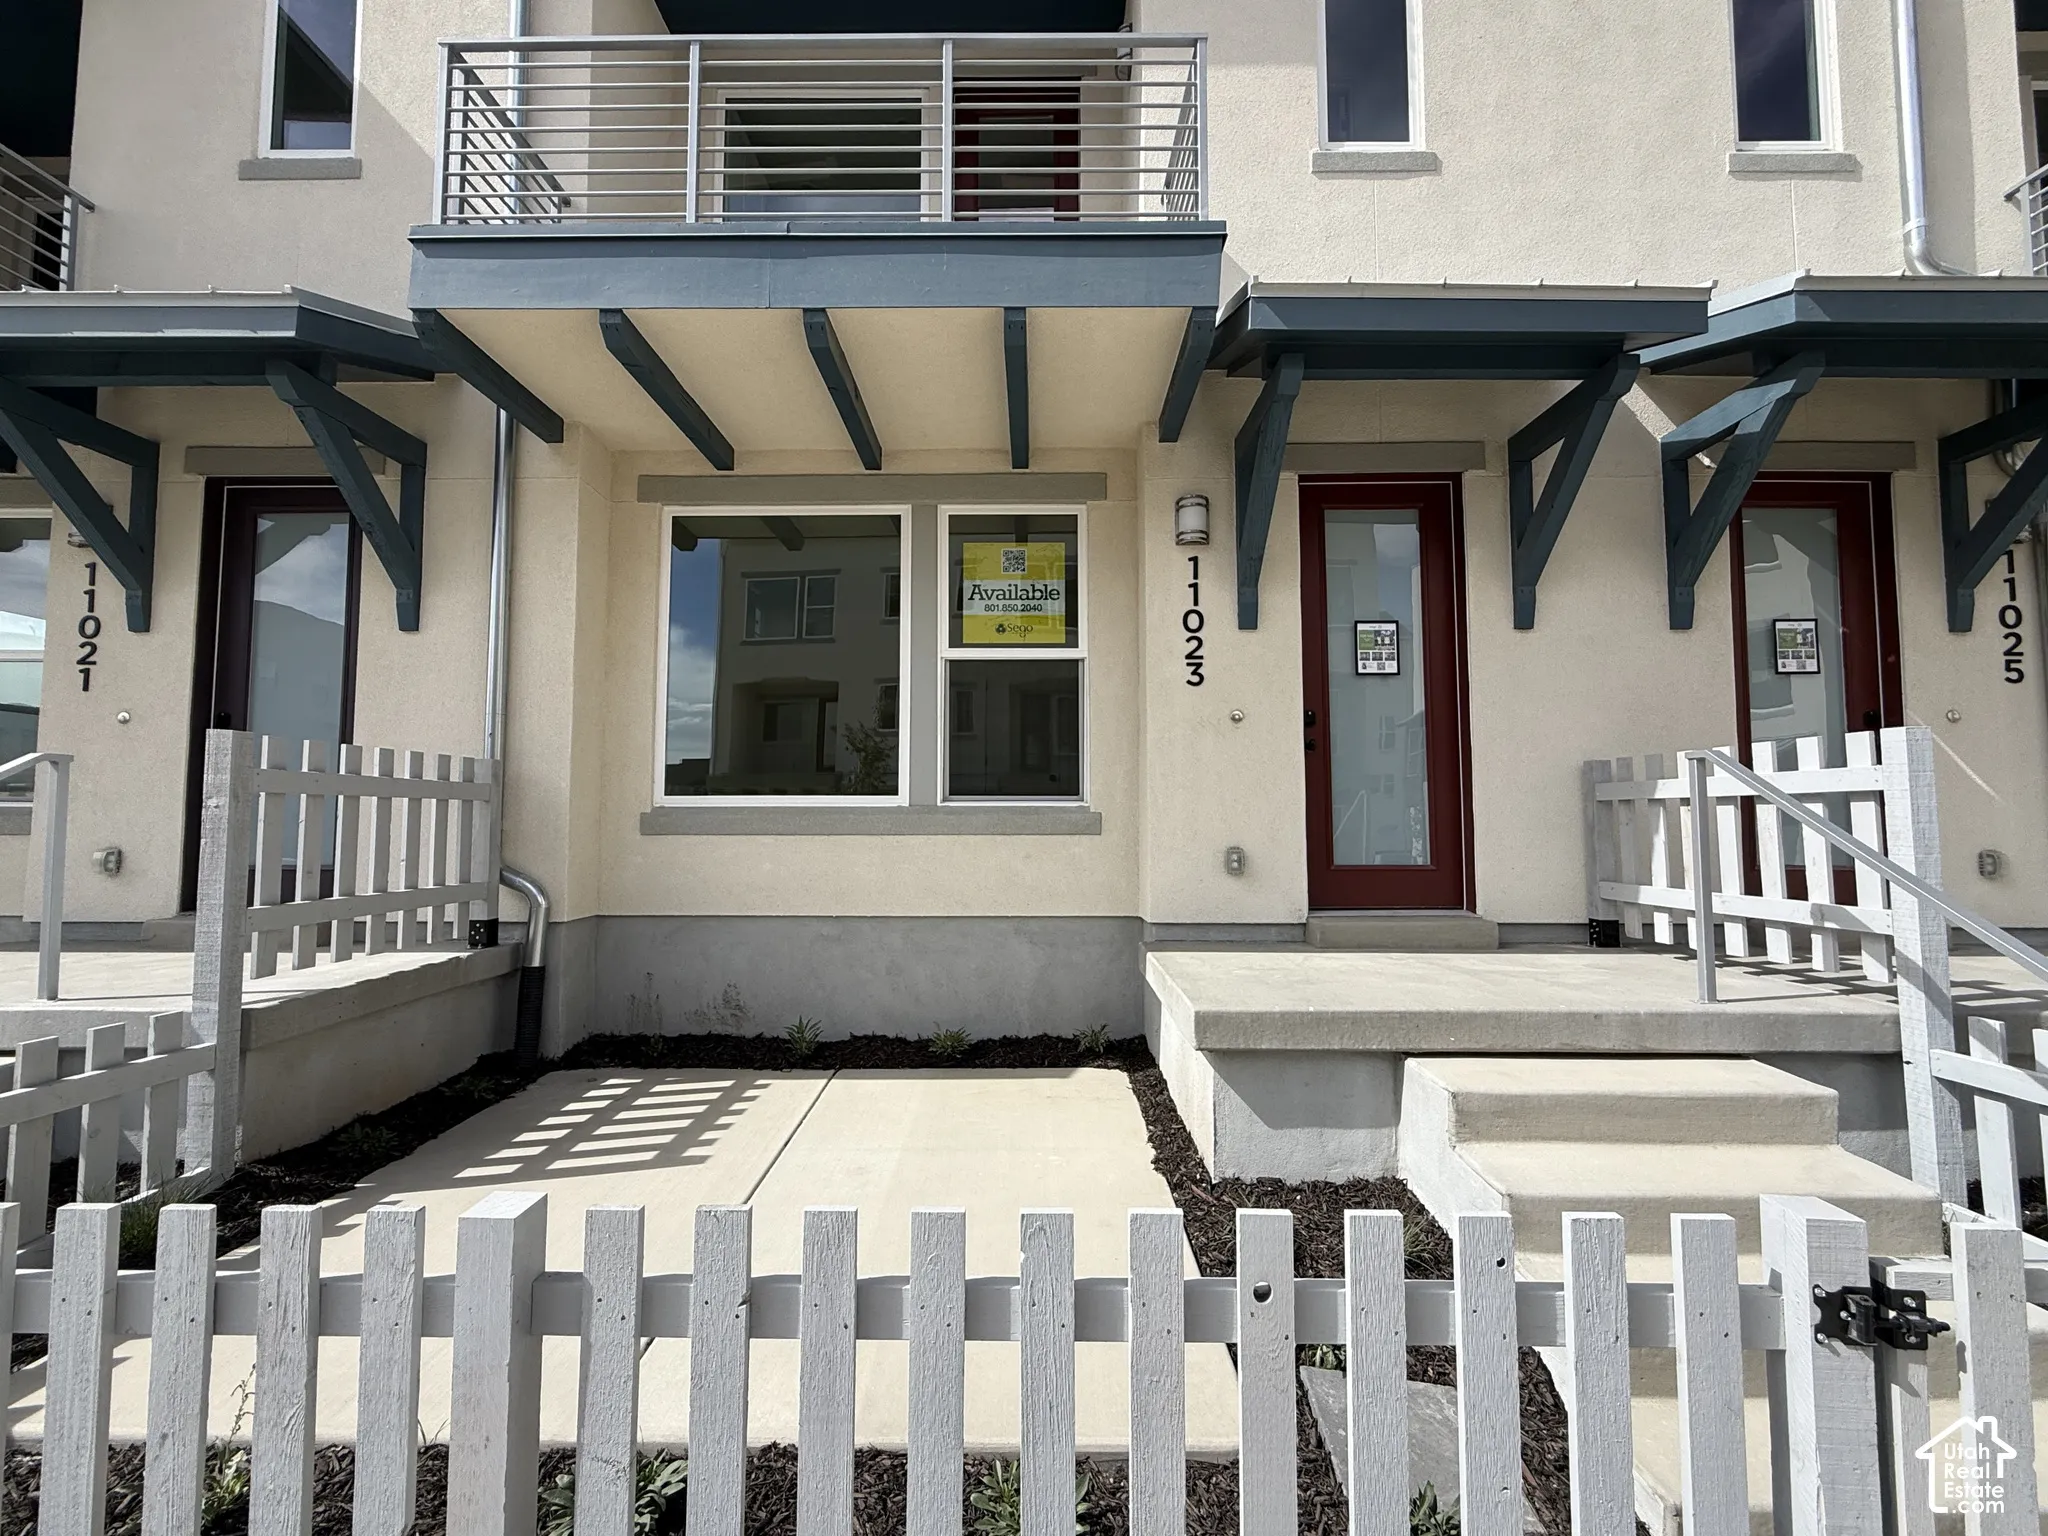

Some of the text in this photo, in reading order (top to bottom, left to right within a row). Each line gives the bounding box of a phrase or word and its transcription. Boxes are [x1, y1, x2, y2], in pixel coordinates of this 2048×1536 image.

[76, 561, 101, 692] 11021
[967, 583, 1060, 601] Available
[984, 603, 1043, 613] 801.850.2040
[1182, 555, 1205, 687] 11023
[1998, 549, 2025, 684] 11025
[1006, 623, 1034, 640] Sego
